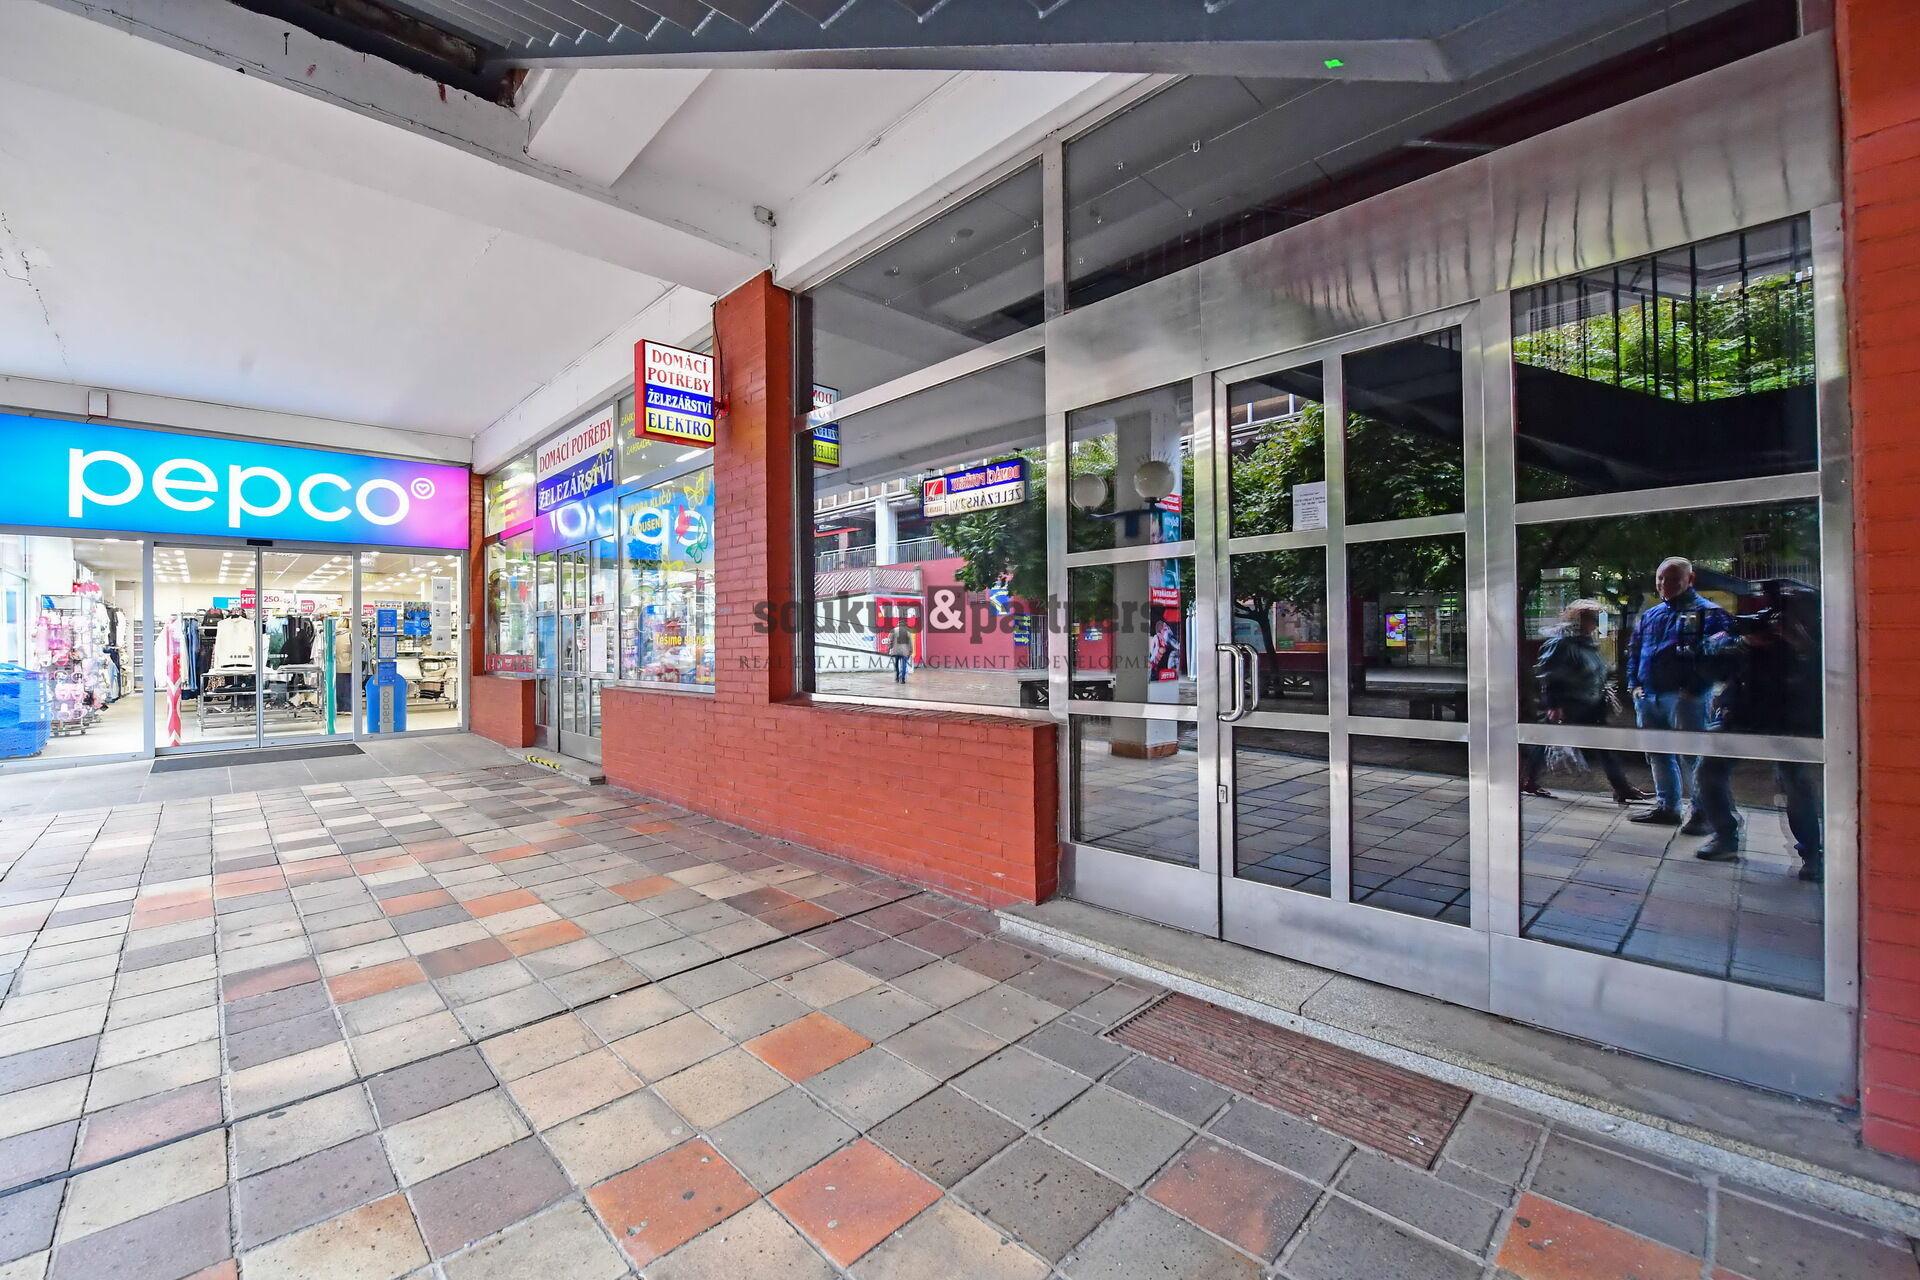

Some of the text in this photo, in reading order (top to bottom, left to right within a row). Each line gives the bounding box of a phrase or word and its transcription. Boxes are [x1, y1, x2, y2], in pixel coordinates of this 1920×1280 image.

[652, 349, 707, 374] DOMÁCÍ
[647, 388, 712, 416] ŽELEZÁŘSTVÍ
[539, 417, 613, 472] DOMÁCÍ POTŘEBY
[648, 412, 711, 438] ELEKTRO
[69, 448, 410, 528] pepco
[539, 457, 613, 508] ŽELEZÁŘSTVÍ
